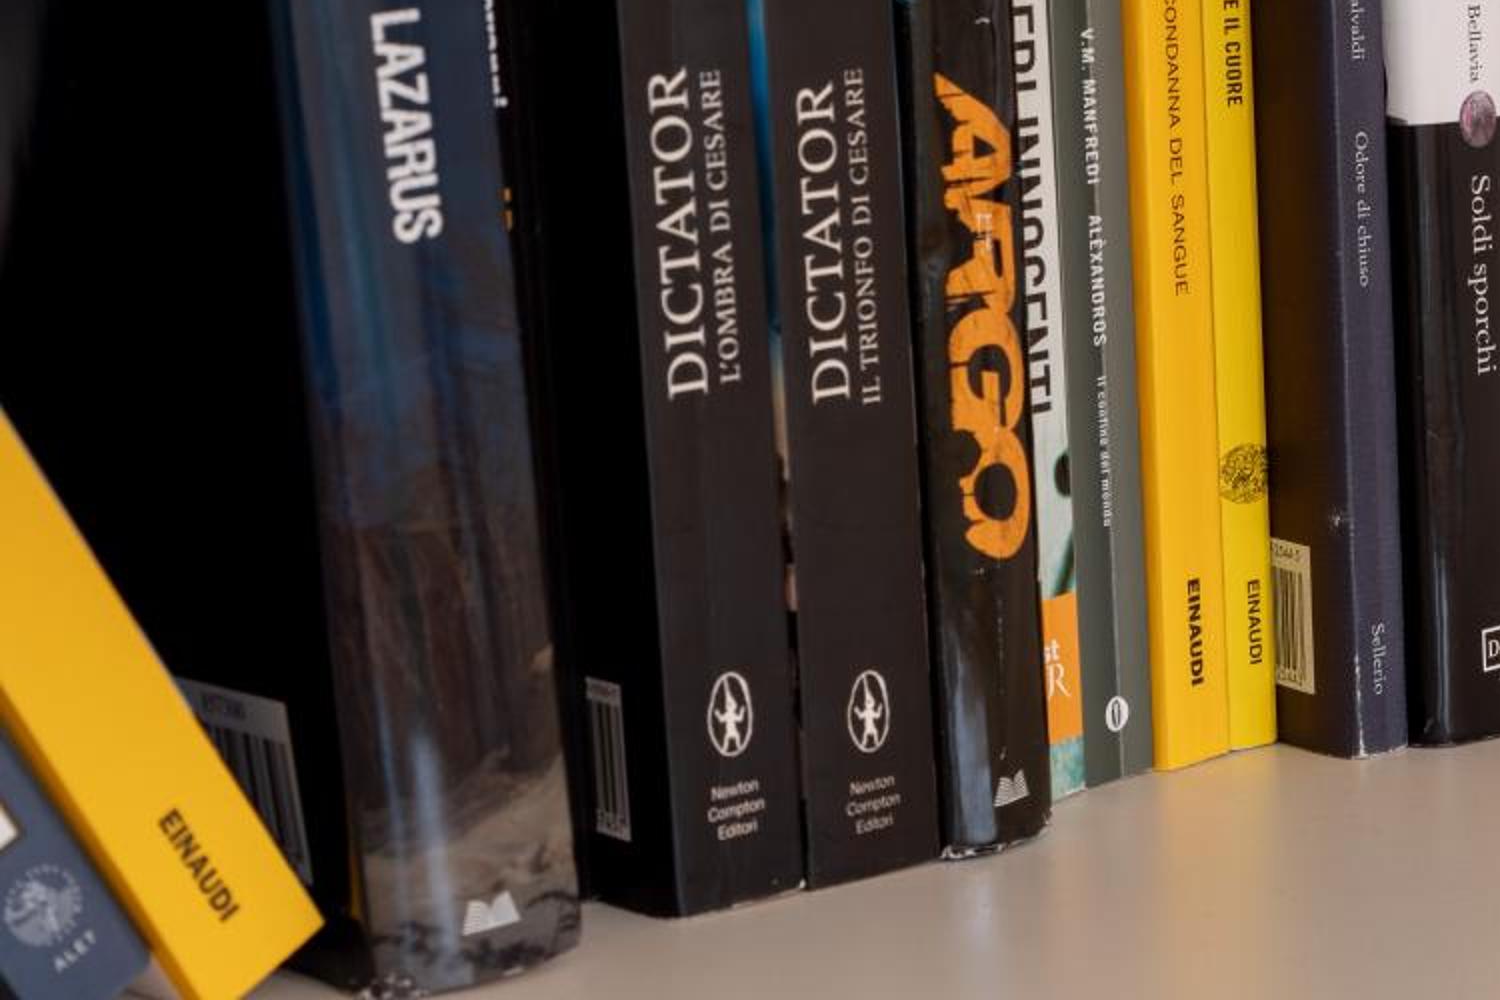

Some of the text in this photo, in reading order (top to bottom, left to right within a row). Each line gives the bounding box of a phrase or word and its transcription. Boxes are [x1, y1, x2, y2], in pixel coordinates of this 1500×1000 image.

[1223, 15, 1241, 35] IL
[1466, 3, 1483, 84] Bellavia
[1223, 40, 1244, 108] CUORE
[370, 8, 444, 245] LAZARUS
[1081, 78, 1101, 186] MANFREDI
[1168, 136, 1185, 185] DEL
[1354, 130, 1370, 195] Odore
[648, 67, 710, 401] DICTATOR
[700, 69, 741, 386] L'OMBRA DI CESARE
[796, 80, 852, 407] DICTATOR
[843, 67, 882, 407] IL TRIONFO DI CESARE
[1169, 192, 1193, 297] SANGUE
[1356, 199, 1372, 220] di
[1357, 225, 1372, 289] chiuso
[1467, 173, 1498, 376] Soldi sporchi
[934, 70, 1031, 560] ARGO
[1187, 577, 1205, 688] EINAUDI
[1246, 578, 1264, 666] EINAUDI
[1371, 621, 1385, 696] Sellerio
[706, 797, 767, 825] Compton
[710, 777, 760, 802] Newton
[845, 792, 902, 818] Compton
[849, 774, 896, 796] Newton
[854, 812, 895, 836] Editori
[157, 808, 240, 923] EINAUDI
[716, 817, 760, 842] Editori
